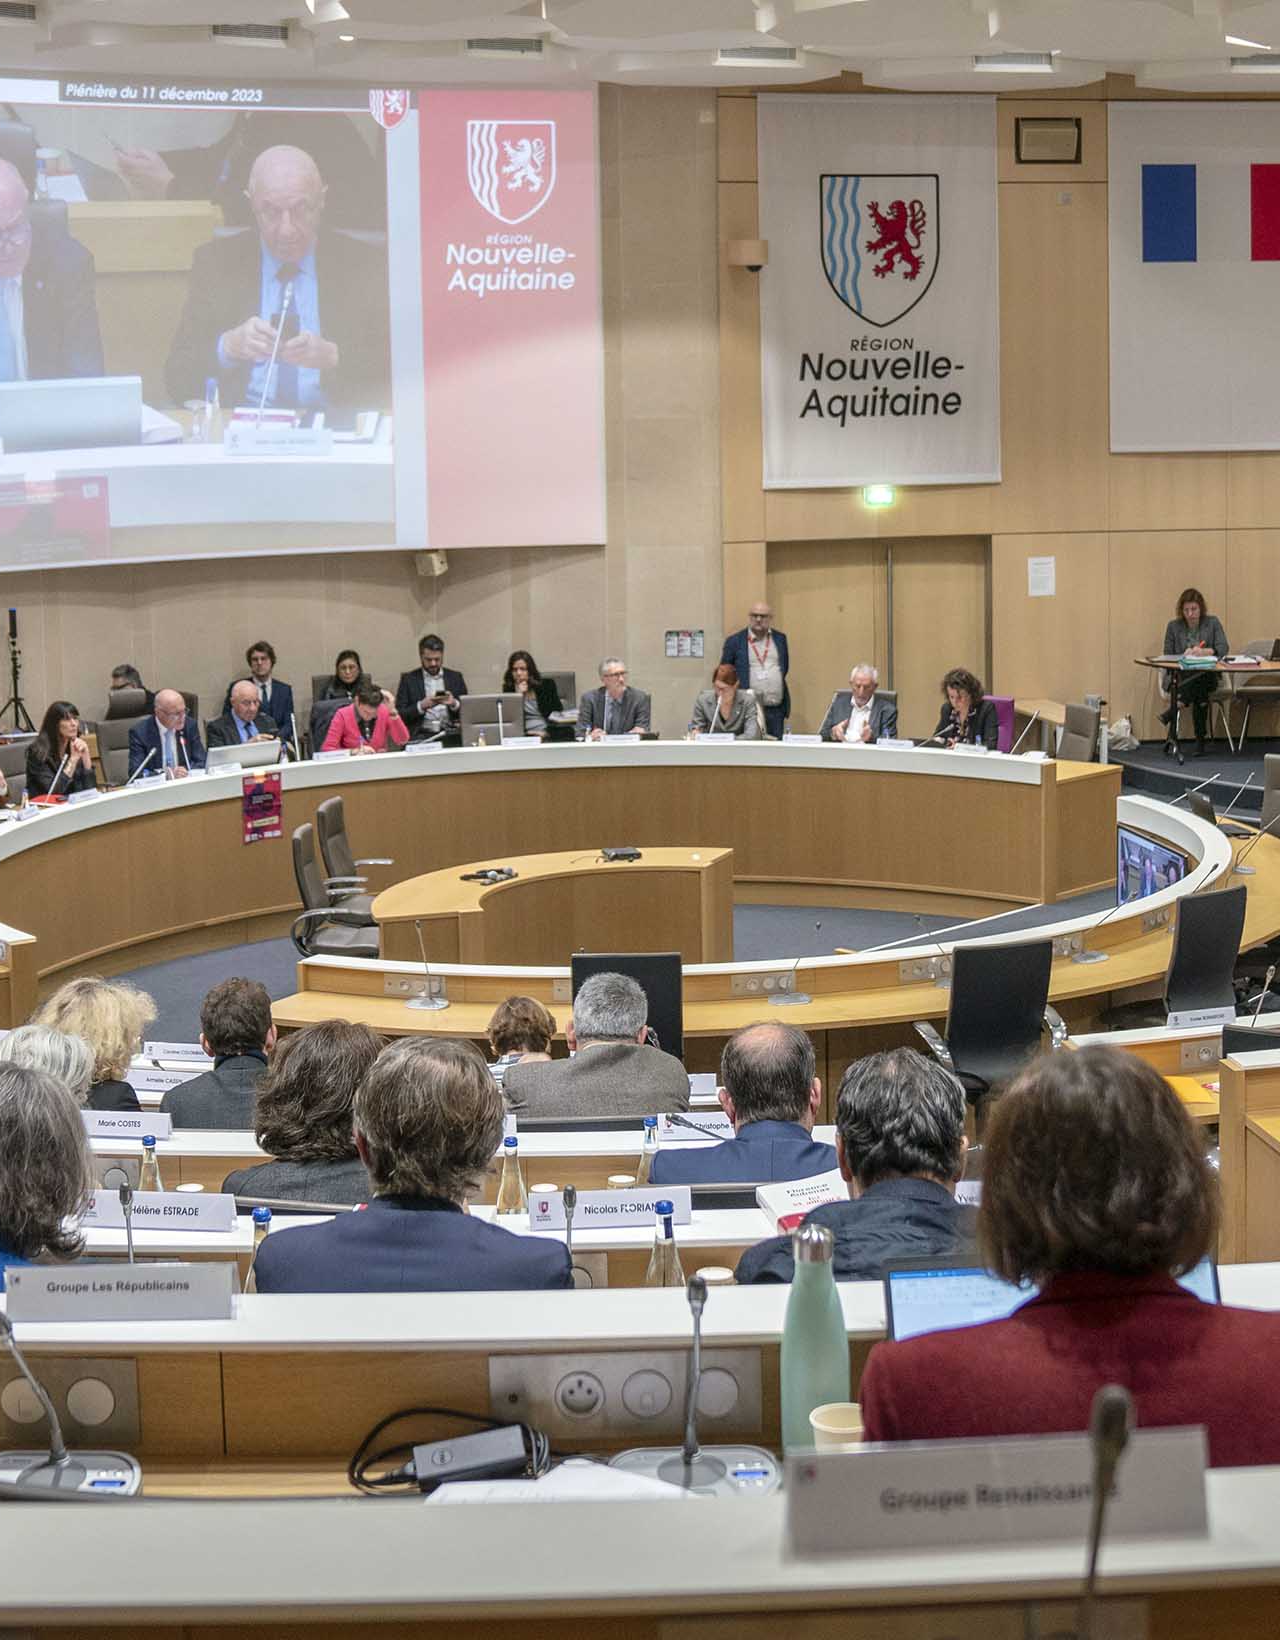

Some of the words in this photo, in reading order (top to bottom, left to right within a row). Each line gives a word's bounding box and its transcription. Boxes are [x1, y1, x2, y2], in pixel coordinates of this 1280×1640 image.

[66, 82, 118, 99] Plénière
[120, 86, 138, 99] du
[141, 86, 156, 99] 11
[159, 85, 229, 102] décembre
[231, 89, 264, 102] 2023
[446, 242, 576, 265] Nouvelle-
[447, 267, 576, 298] Aquitaine
[850, 336, 915, 352] RÉGION
[799, 350, 965, 381] Nouvelle-
[799, 385, 962, 428] Aquitaine
[97, 1119, 116, 1128] Marie
[117, 1119, 142, 1128] COSTES
[163, 1206, 200, 1217] ESTRADE
[584, 1204, 618, 1215] Nicolas
[46, 1281, 90, 1295] Groupe
[92, 1280, 113, 1292] Les
[115, 1278, 190, 1294] Républicains
[879, 1487, 968, 1513] Groupe
